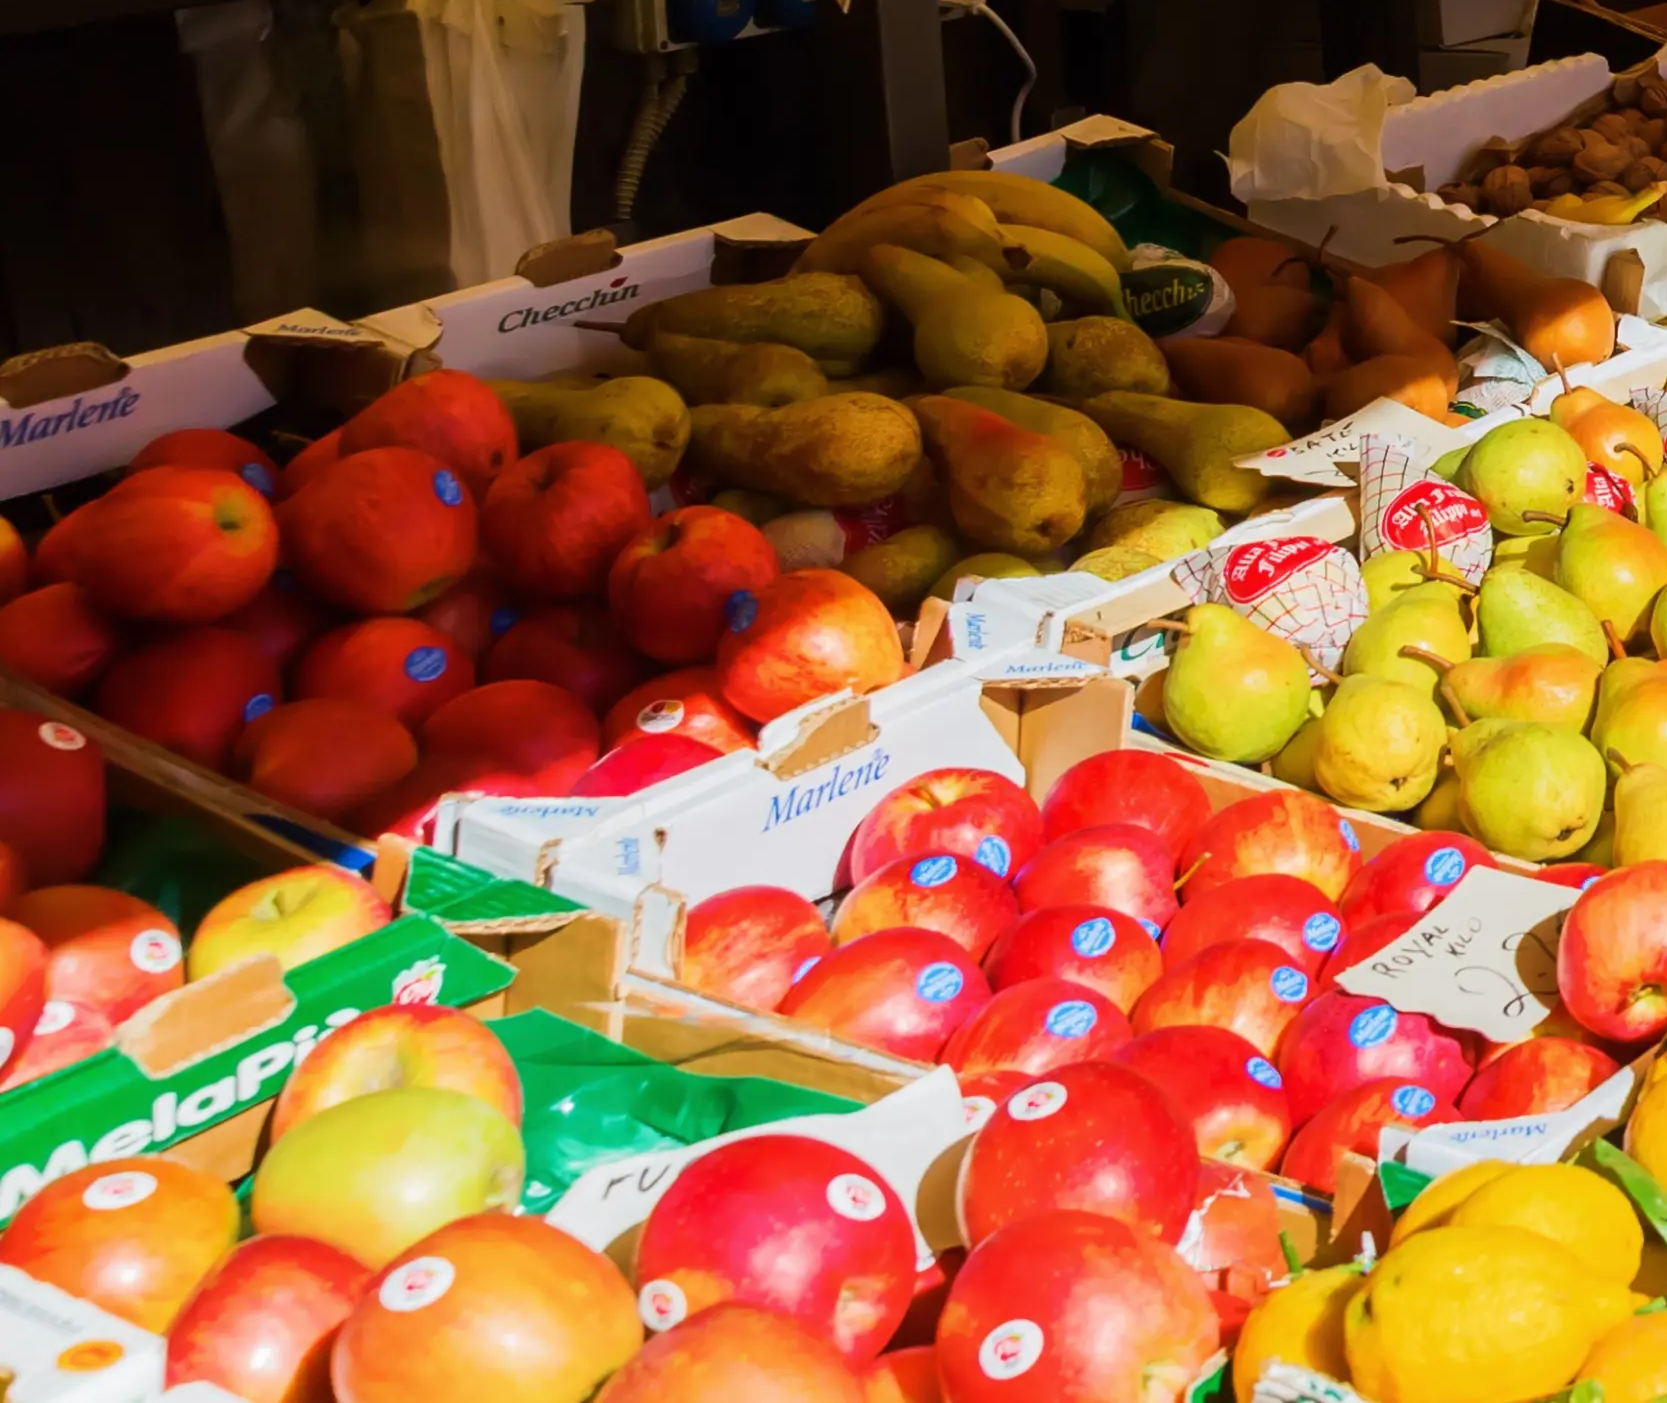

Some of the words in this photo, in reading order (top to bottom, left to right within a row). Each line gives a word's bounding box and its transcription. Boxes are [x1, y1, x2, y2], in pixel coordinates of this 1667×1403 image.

[498, 282, 641, 334] Checchin
[0, 391, 140, 449] Marlene
[762, 752, 892, 833] Marlene
[1370, 924, 1451, 979] ROYAL
[1447, 916, 1482, 959] KILO
[0, 1006, 363, 1226] MelaPi
